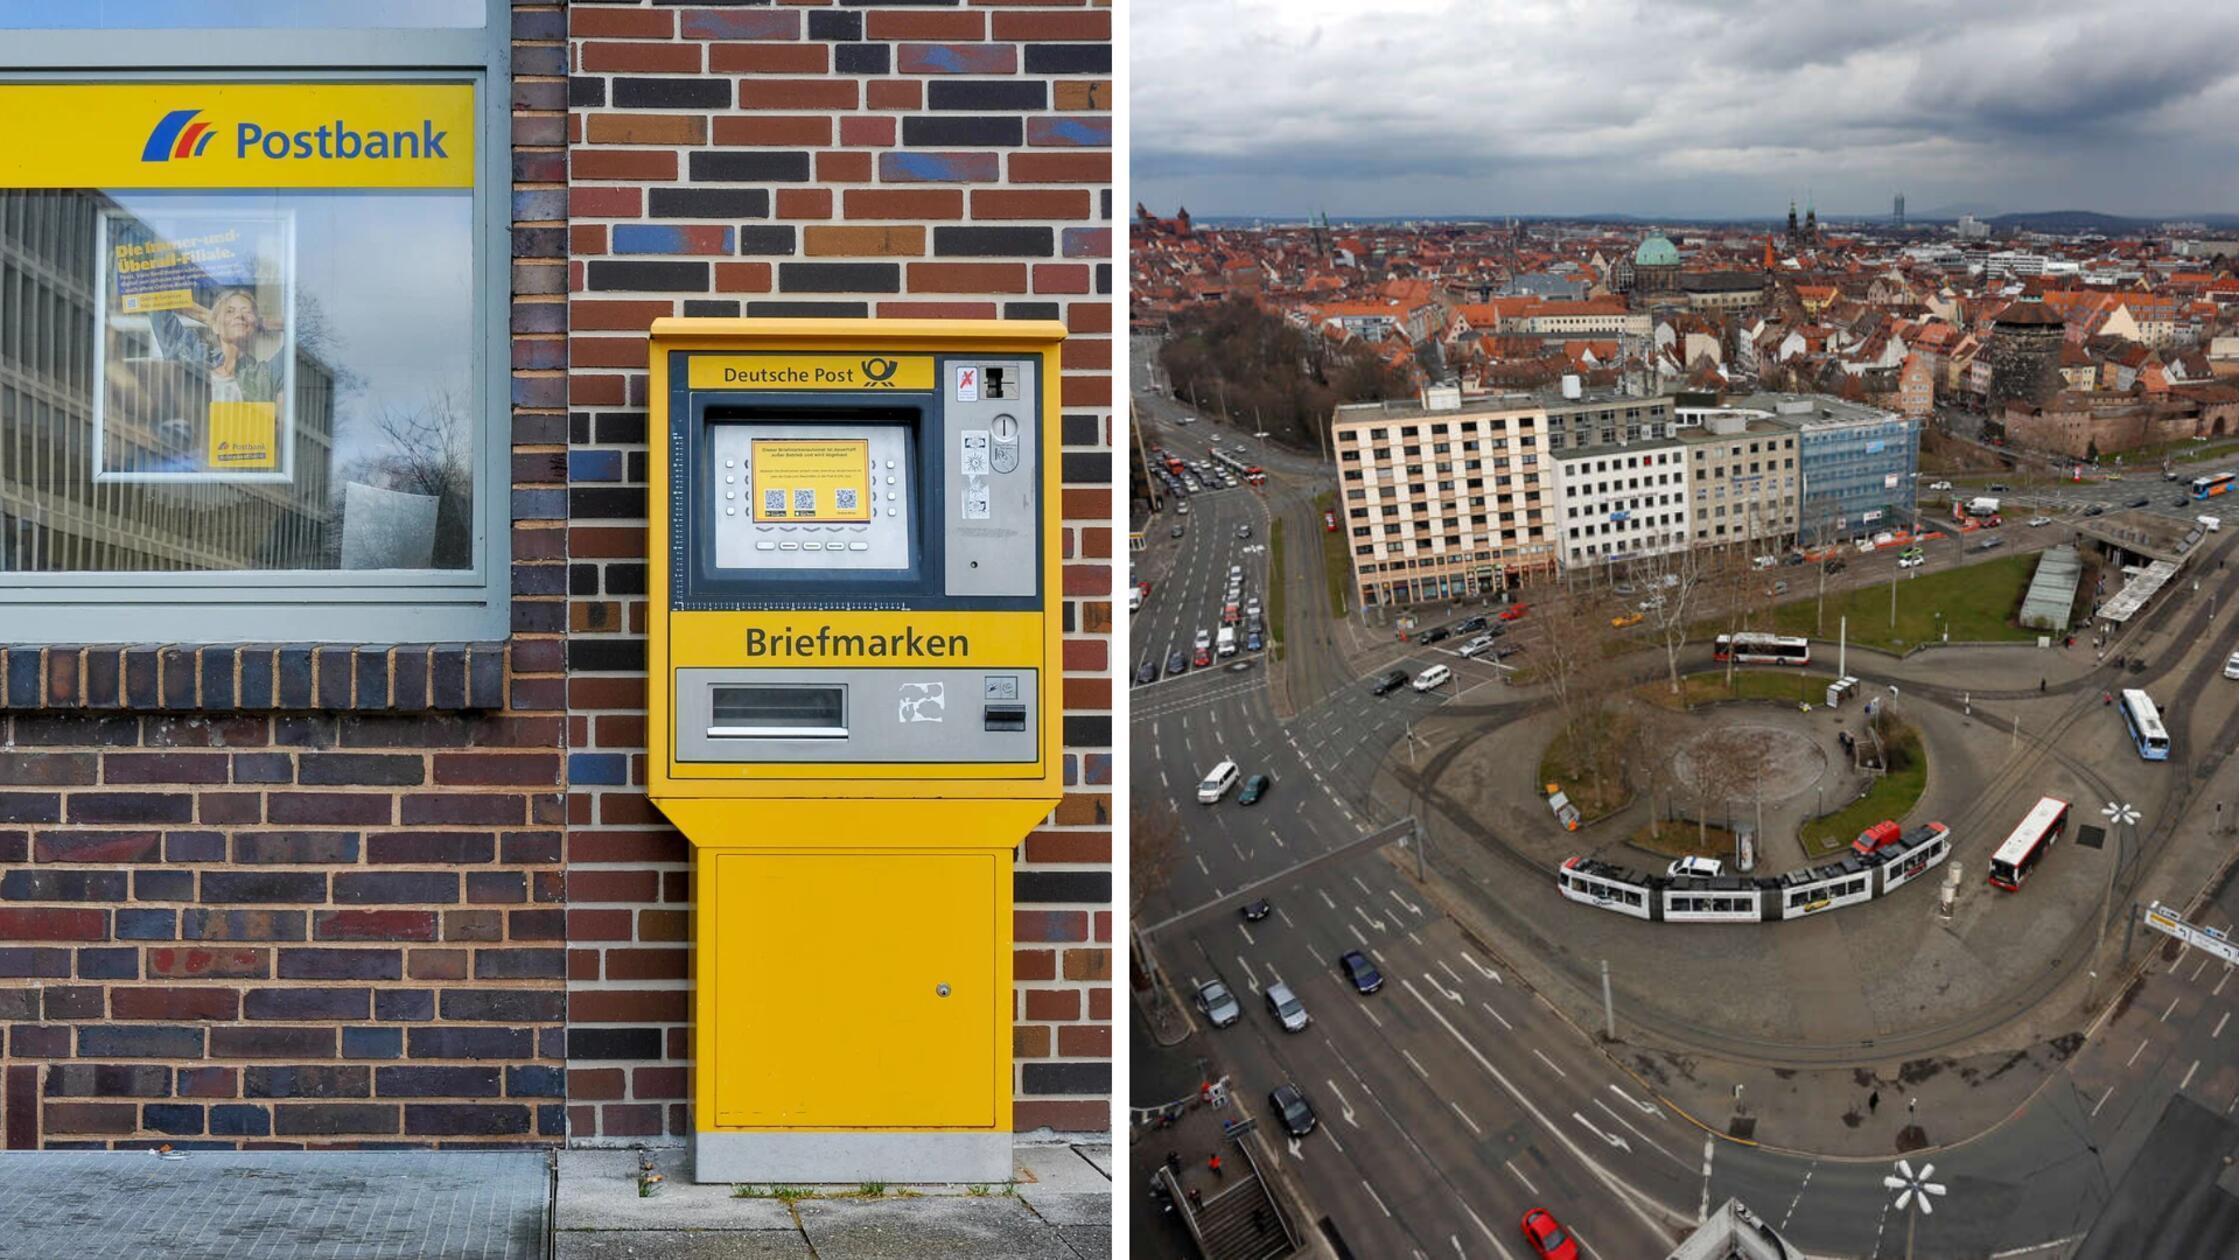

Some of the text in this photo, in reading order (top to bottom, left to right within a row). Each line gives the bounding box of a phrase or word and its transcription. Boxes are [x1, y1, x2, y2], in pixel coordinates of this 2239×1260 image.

[237, 120, 449, 159] Postbank
[724, 367, 854, 382] Deutsche Post
[746, 626, 969, 656] Briefmarken
